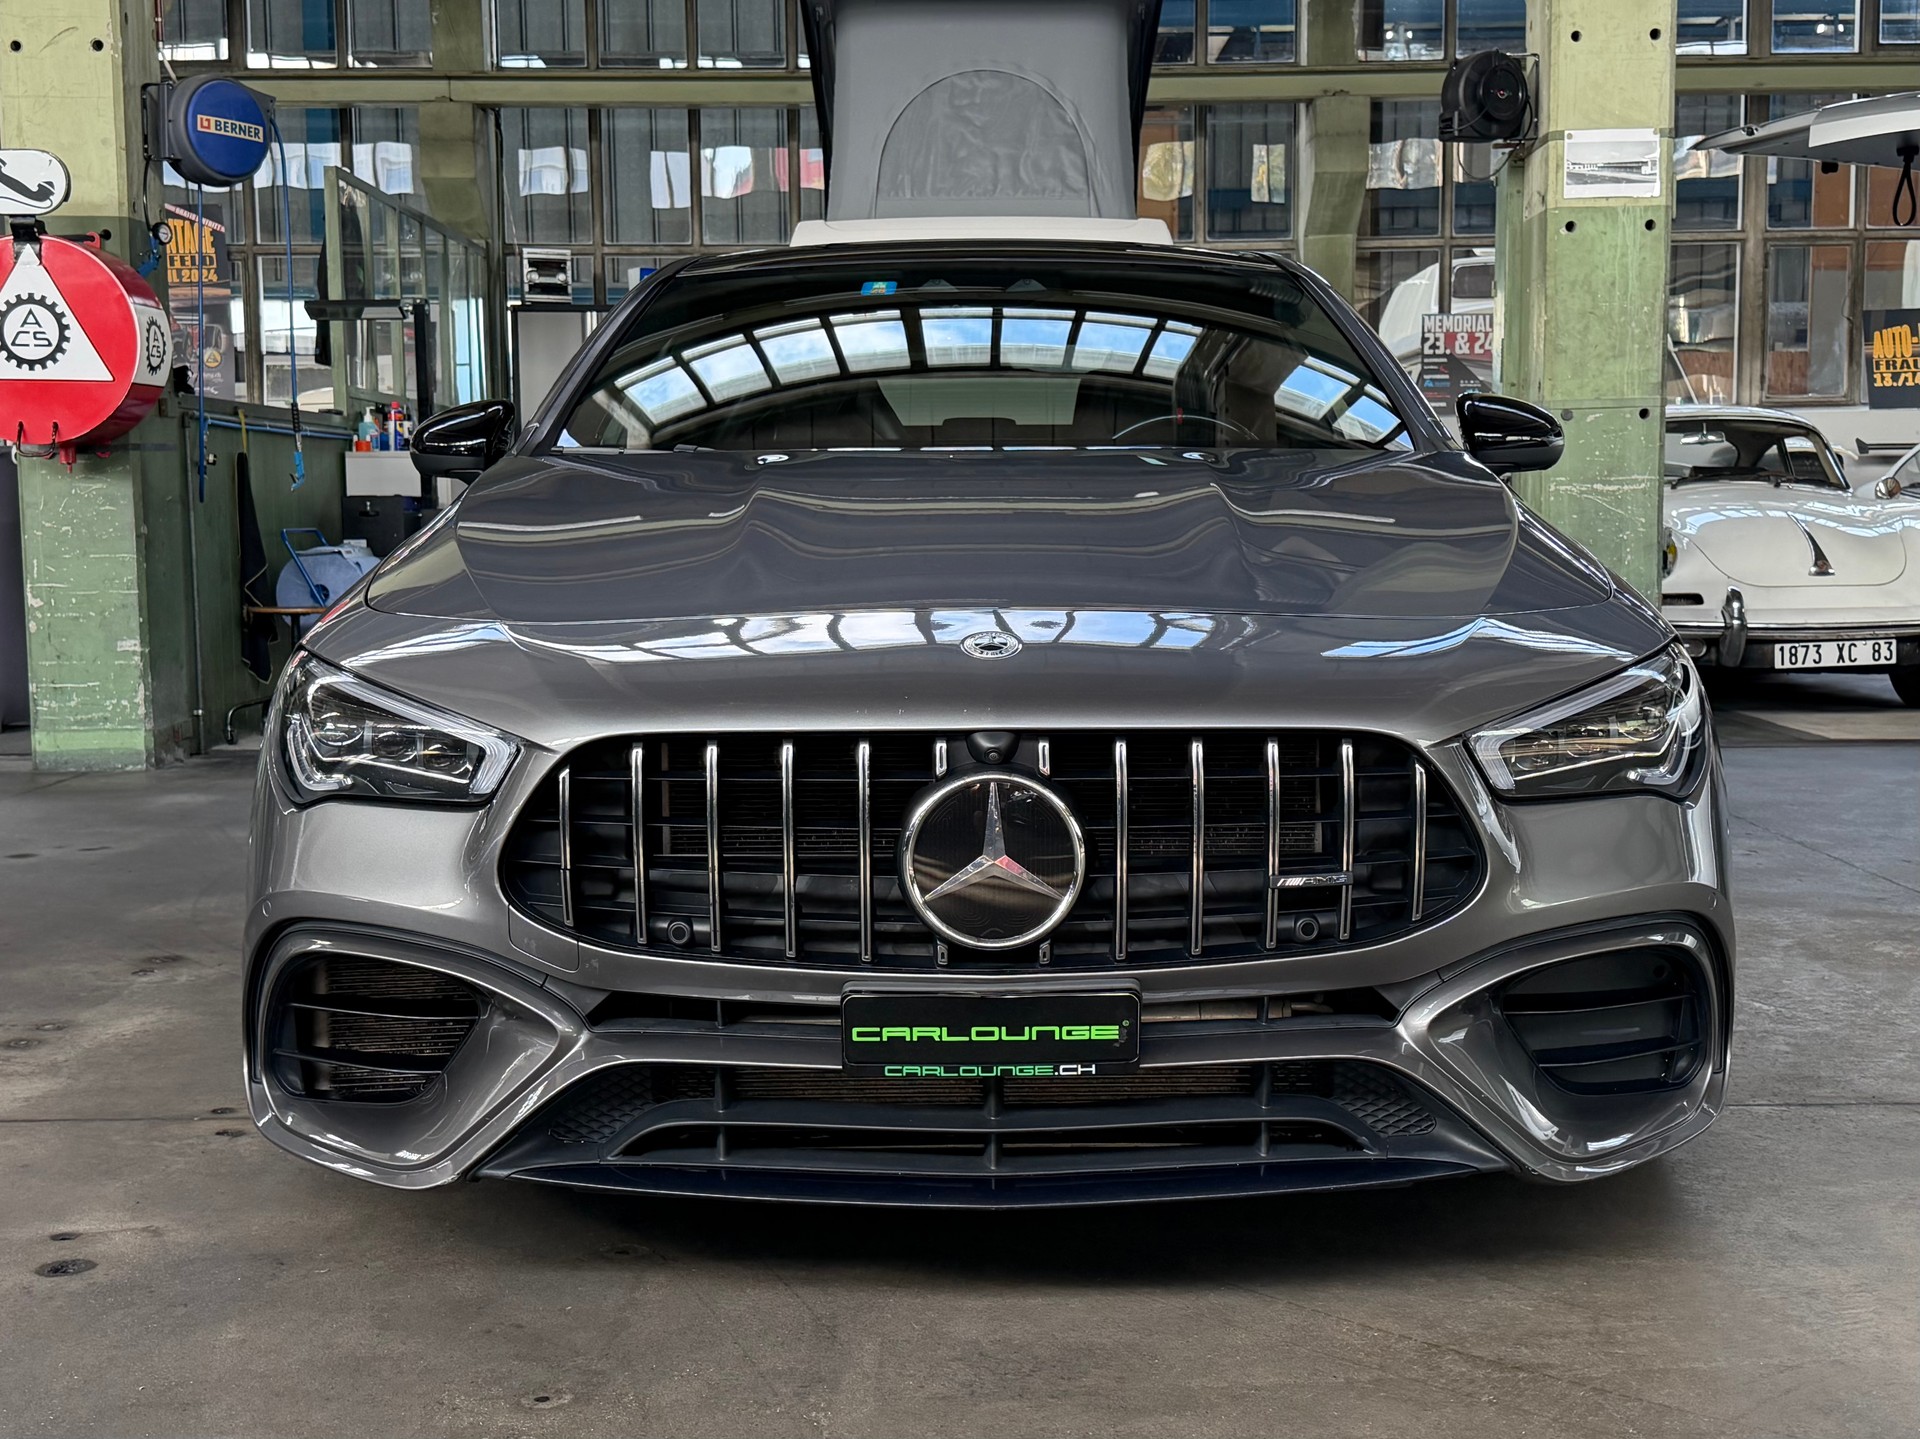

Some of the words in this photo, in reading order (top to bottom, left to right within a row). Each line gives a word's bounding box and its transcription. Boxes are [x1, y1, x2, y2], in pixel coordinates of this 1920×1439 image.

[214, 119, 261, 140] BERNER
[181, 268, 218, 282] 2024
[20, 307, 42, 328] A
[1423, 314, 1492, 333] MEMORIAL
[1423, 332, 1451, 355] 23.
[1455, 332, 1470, 355] &
[1873, 323, 1920, 358] AUTO-
[1779, 644, 1822, 666] 1873
[1836, 643, 1857, 663] XC
[1872, 641, 1893, 662] 83
[885, 1063, 1096, 1077] CARLOUNGE.CH
